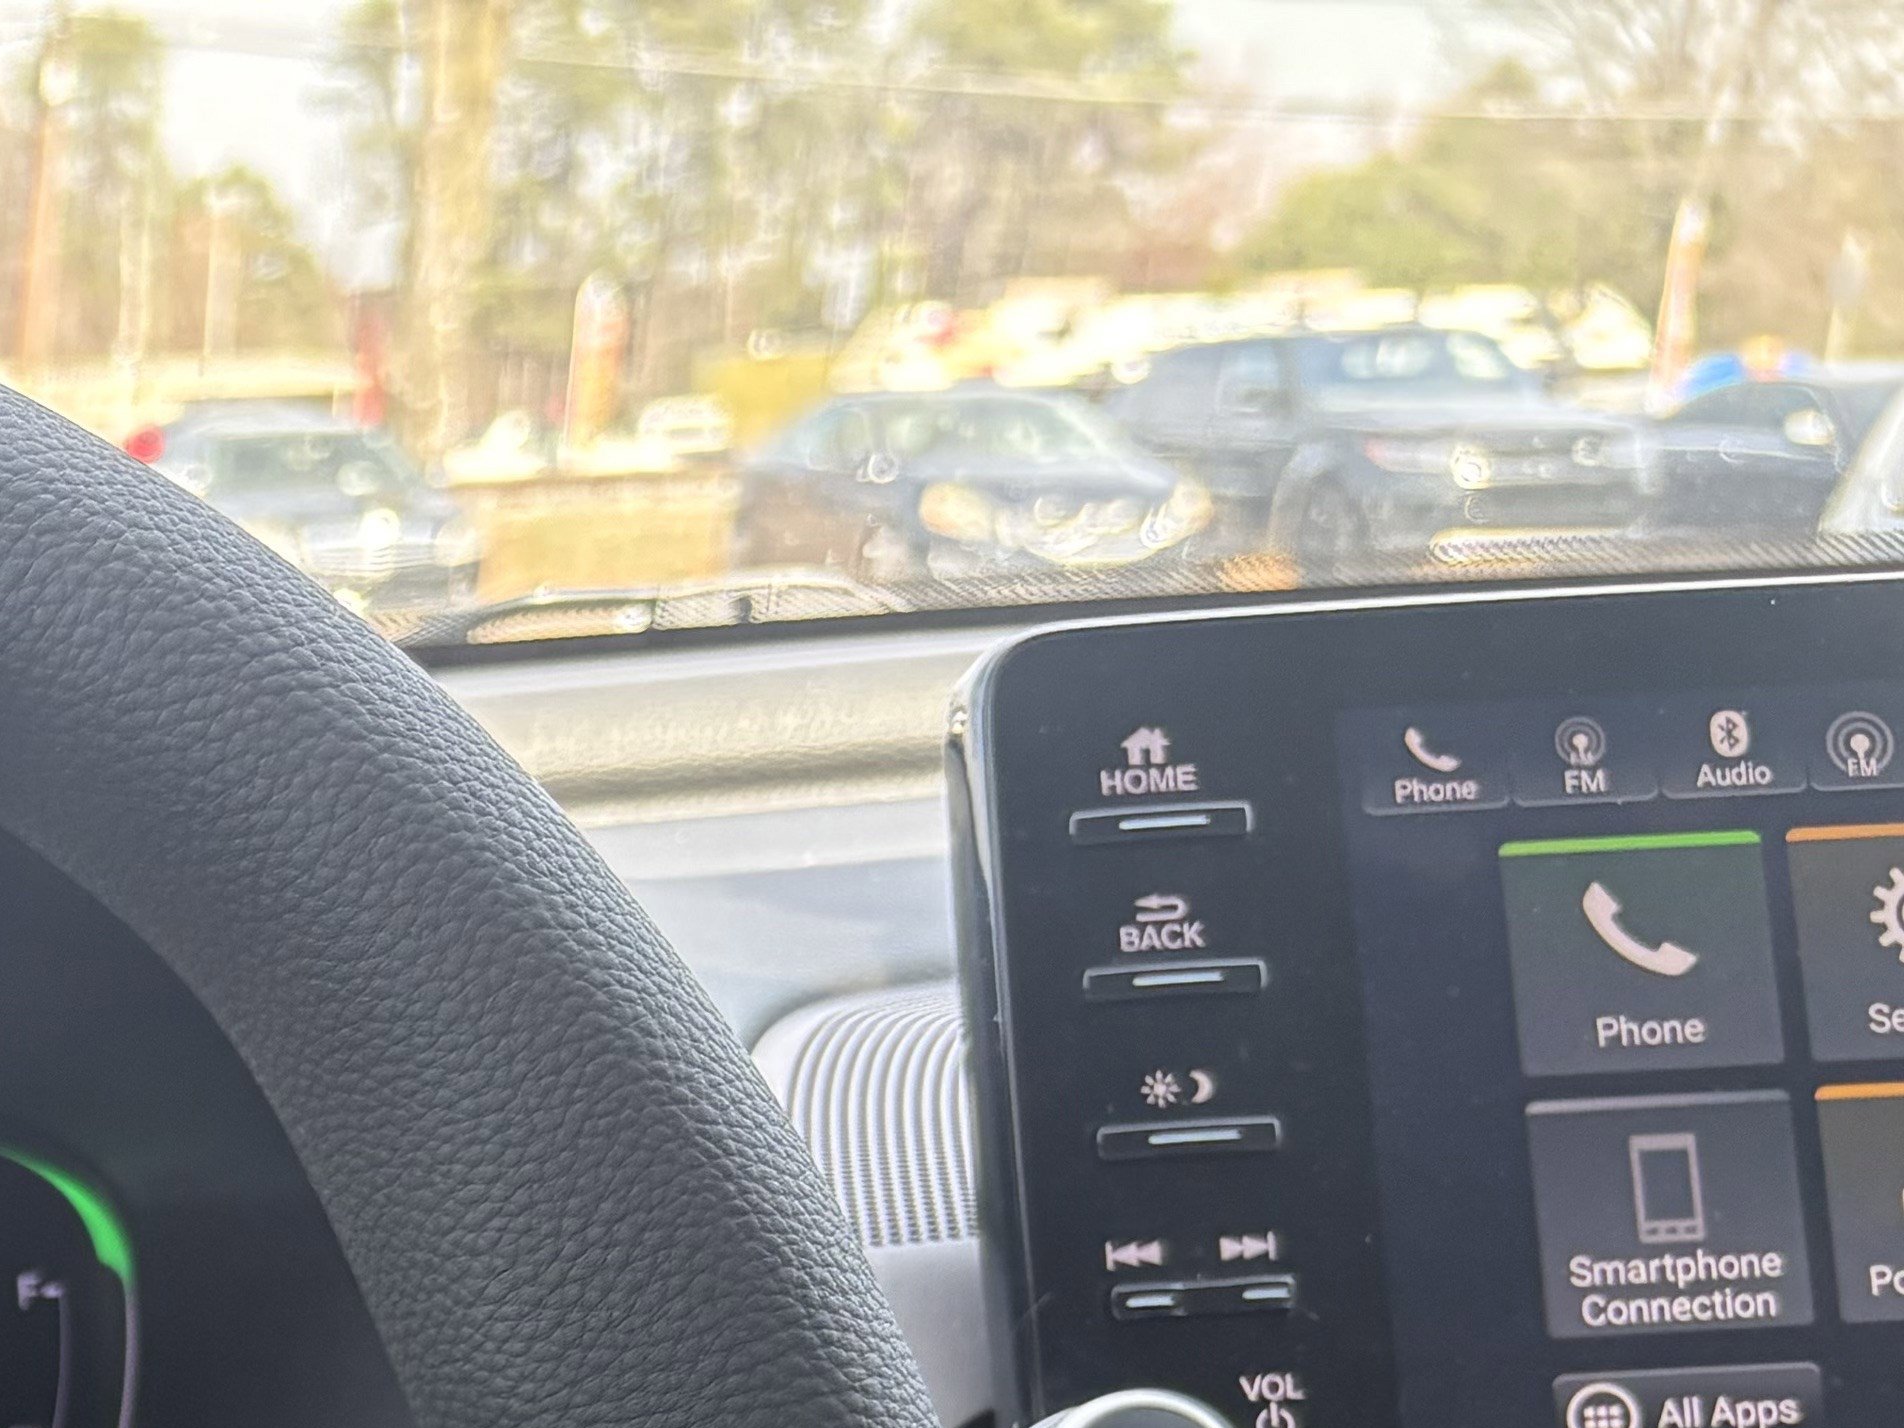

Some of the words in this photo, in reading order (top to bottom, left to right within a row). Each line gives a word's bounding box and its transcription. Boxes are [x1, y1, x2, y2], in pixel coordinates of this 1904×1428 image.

[1099, 763, 1200, 796] HOME
[1563, 768, 1607, 794] FM
[1696, 759, 1773, 789] Audio
[1847, 758, 1879, 777] FM
[1393, 777, 1479, 804] Phone
[1118, 920, 1207, 953] BACK
[1596, 1014, 1707, 1048] Phone
[1568, 1249, 1783, 1289] Smartphone
[17, 1270, 41, 1311] F
[1580, 1289, 1778, 1327] Connection
[1238, 1372, 1306, 1401] VOL
